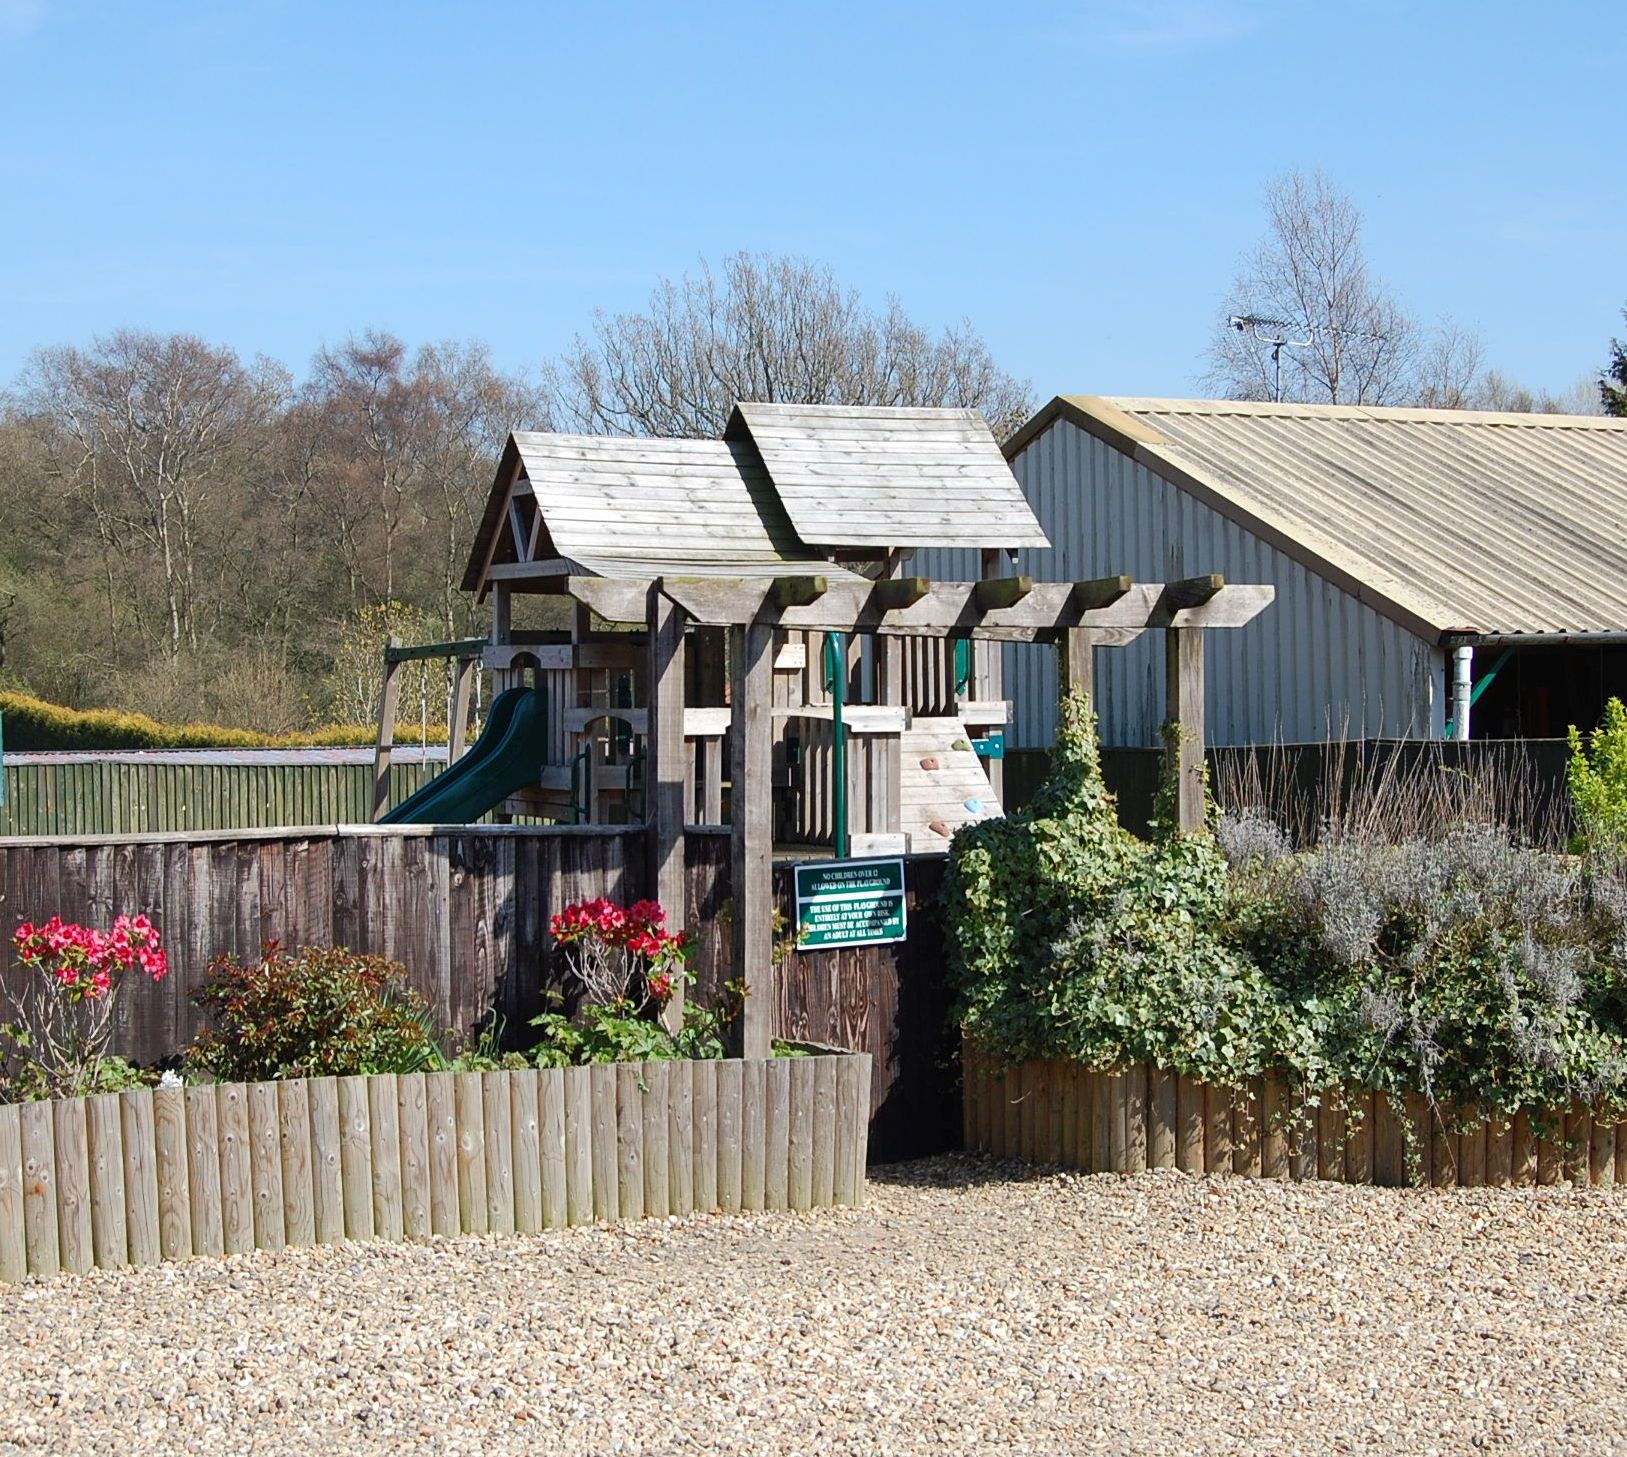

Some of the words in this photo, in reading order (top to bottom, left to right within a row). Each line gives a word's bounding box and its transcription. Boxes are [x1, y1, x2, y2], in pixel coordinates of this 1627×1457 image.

[831, 871, 857, 880] CHILDREN
[858, 870, 872, 878] OVER
[811, 882, 837, 890] ALLOWED
[837, 881, 845, 889] ON
[846, 880, 856, 888] THE
[857, 878, 890, 887] PLAYGROUND
[810, 905, 820, 914] THE
[821, 904, 831, 913] USE
[832, 904, 839, 912] OF
[840, 903, 852, 911] THIS
[853, 900, 887, 910] PLAYGROUND
[814, 913, 840, 923] ENTIRELY
[841, 912, 847, 920] AT
[848, 911, 863, 920] YOUR
[832, 921, 846, 931] MUST
[847, 921, 854, 929] BE
[892, 917, 899, 925] BY
[824, 932, 831, 940] AN
[832, 931, 848, 939] ADULT
[849, 930, 856, 938] AT
[856, 929, 866, 937] ALL
